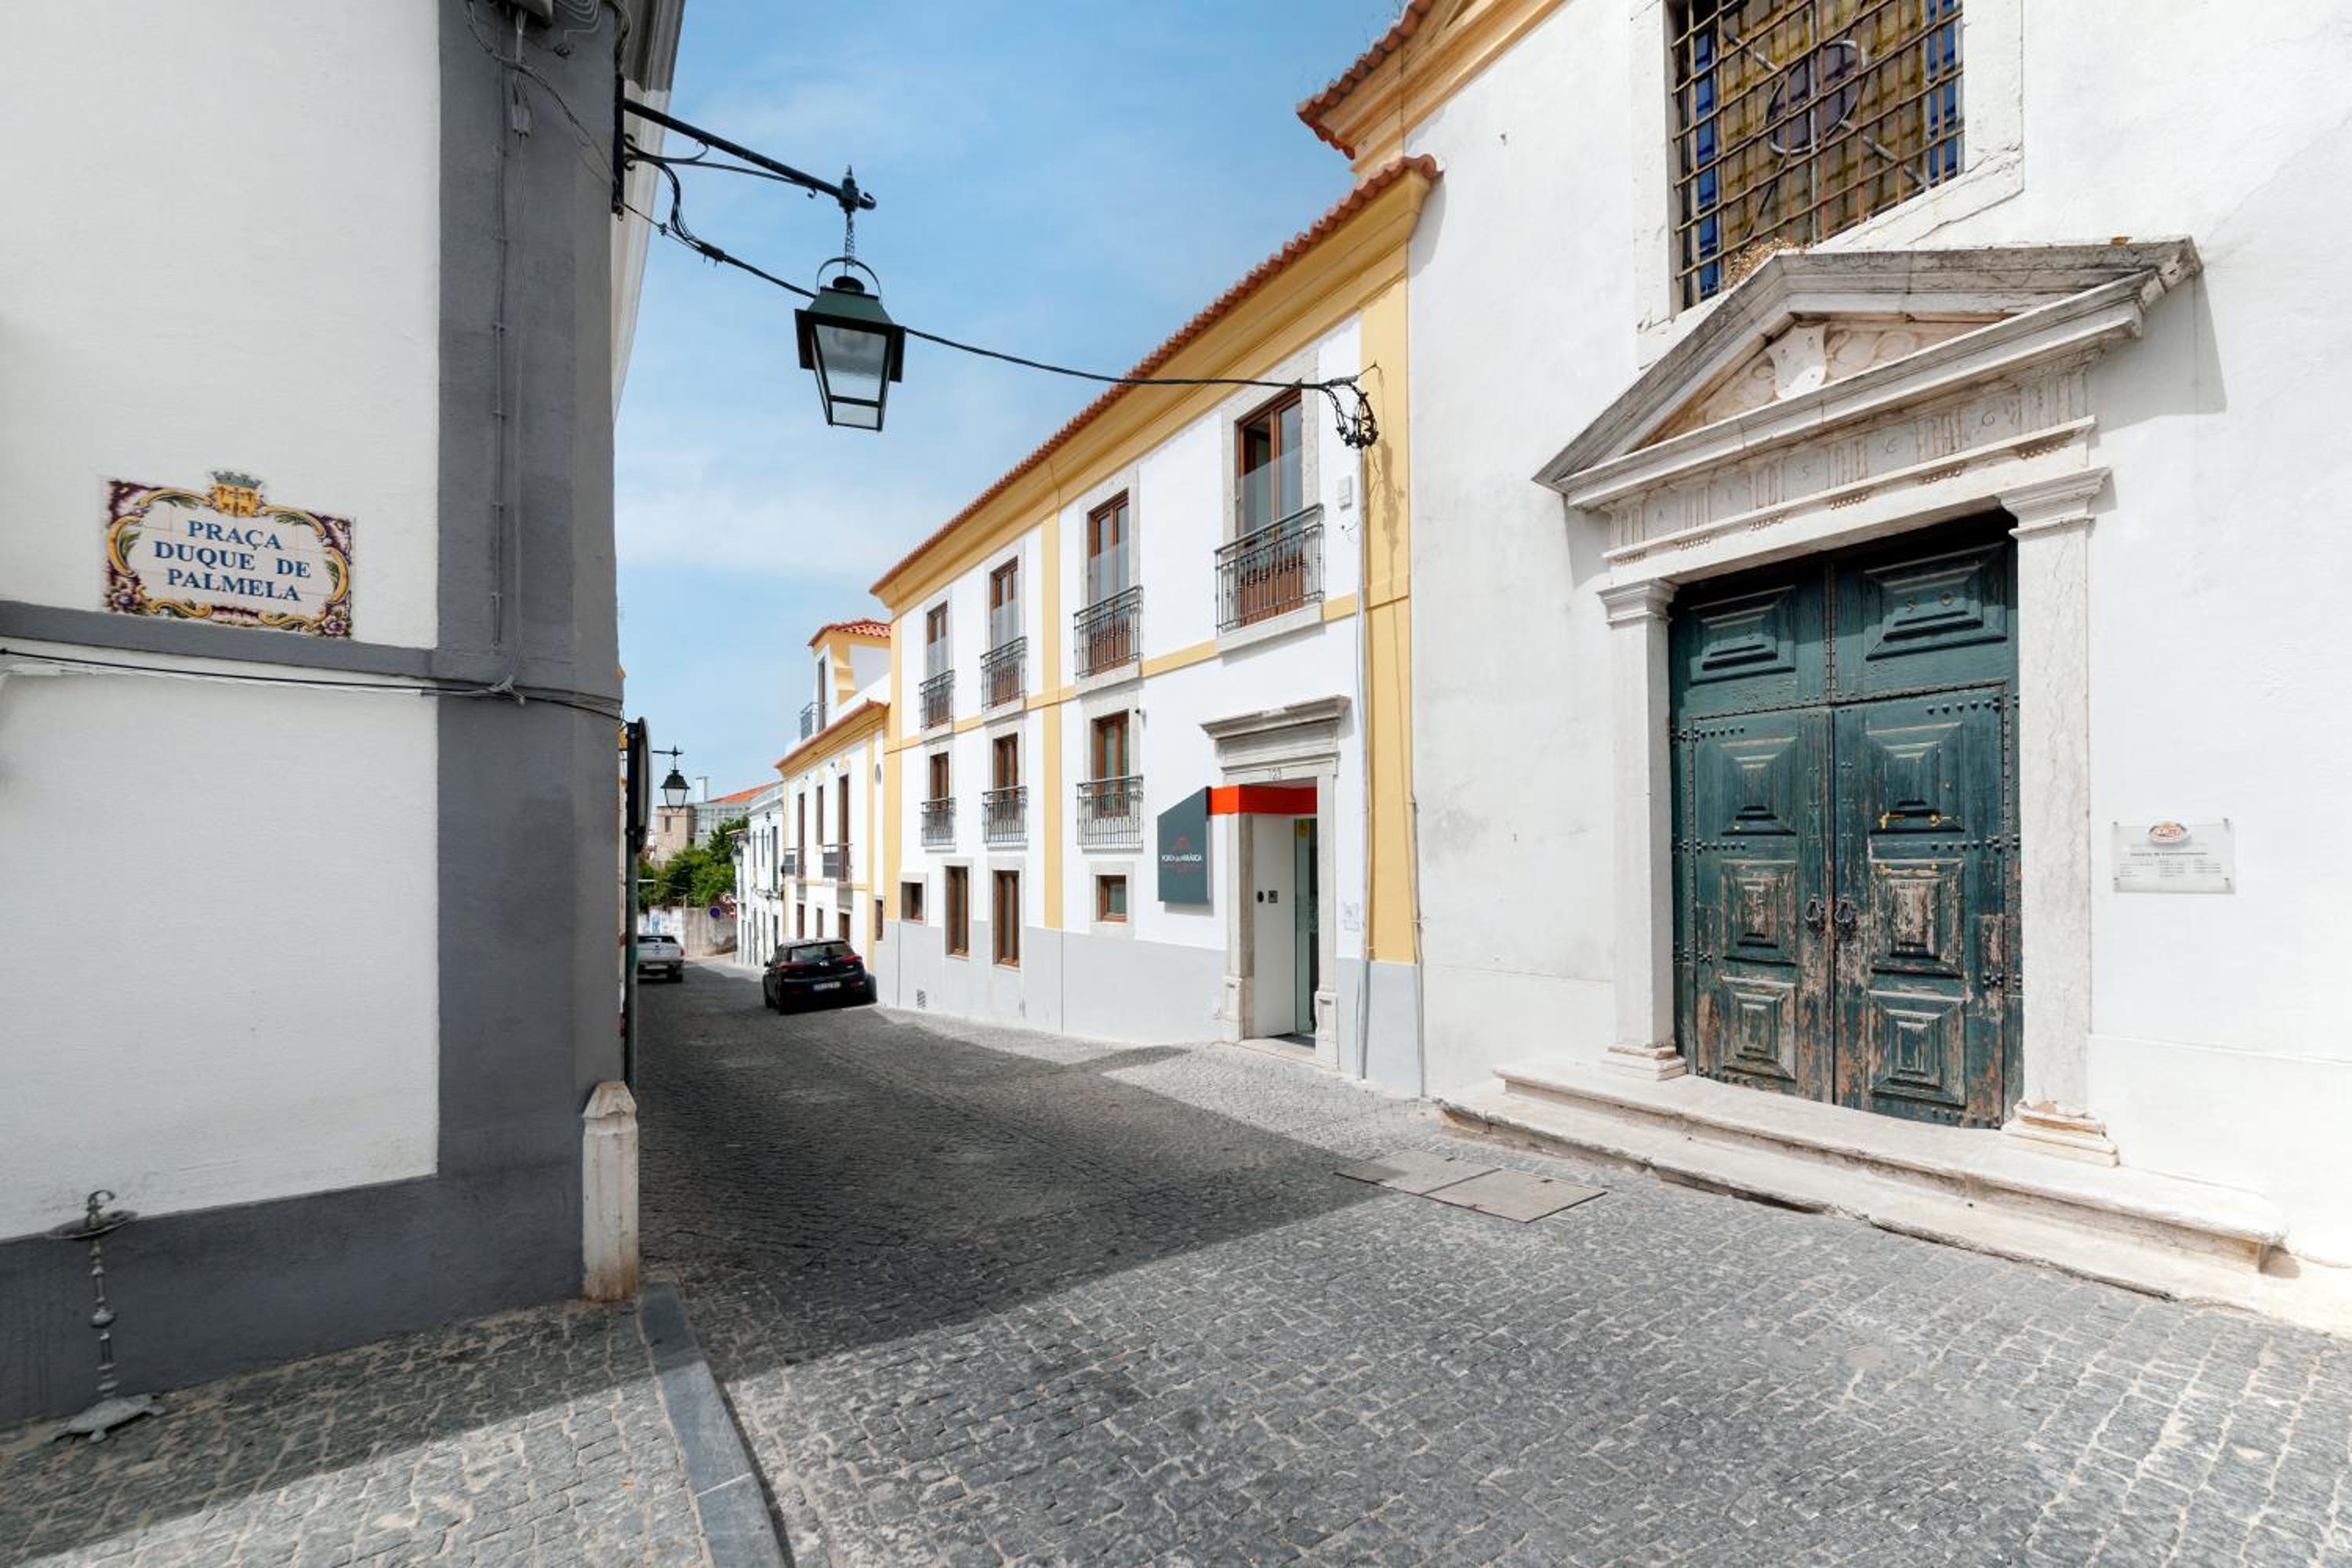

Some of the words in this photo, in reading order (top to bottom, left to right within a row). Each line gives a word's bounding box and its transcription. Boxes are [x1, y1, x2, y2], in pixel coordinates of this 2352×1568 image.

[188, 520, 282, 550] PRAÇA
[154, 540, 255, 571] DUQUE
[276, 557, 310, 578] DE
[168, 568, 301, 601] PALMELA
